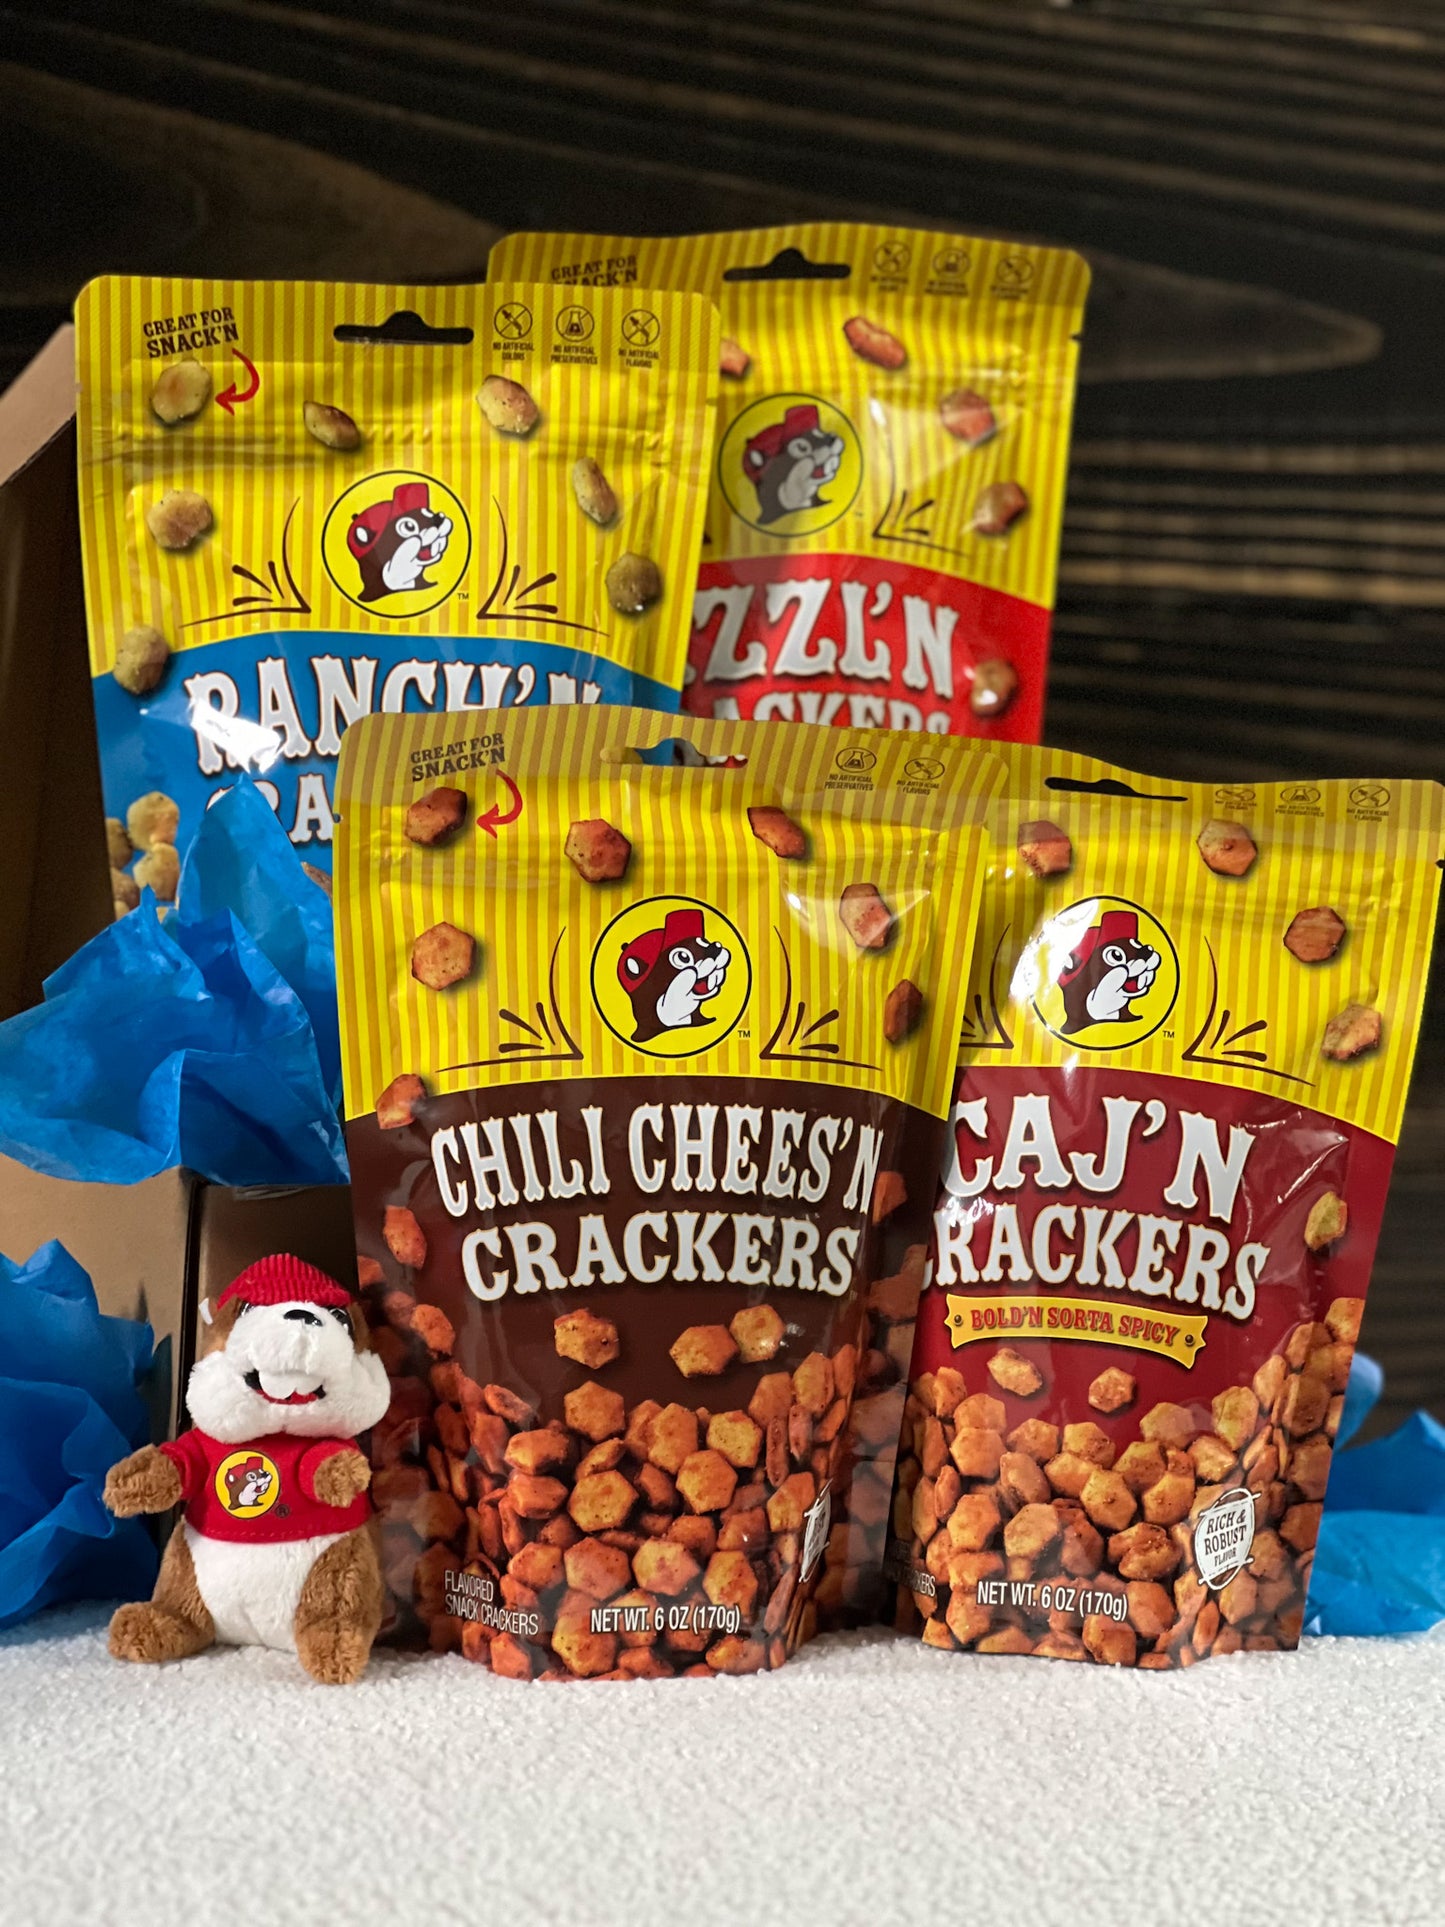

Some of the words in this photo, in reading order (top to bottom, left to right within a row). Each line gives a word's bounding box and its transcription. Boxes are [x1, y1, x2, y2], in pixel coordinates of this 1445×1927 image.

[551, 260, 602, 281] GREAT
[606, 254, 637, 271] FOR
[143, 313, 197, 338] GREAT
[200, 306, 235, 326] FOR
[146, 322, 239, 359] SNACK'N
[410, 741, 467, 764] GREAT
[470, 732, 505, 751] FOR
[411, 746, 506, 783] SNACK'N
[430, 1104, 612, 1217] CHILI
[627, 1101, 885, 1215] CHEES'N
[941, 1092, 1256, 1223] CAJ'N
[461, 1209, 861, 1302] CRACKERS
[921, 1202, 1272, 1321] RACKERS
[970, 1305, 1043, 1331] BOLD'N
[1046, 1307, 1114, 1334] SORTA
[1118, 1313, 1180, 1346] SPICY
[1203, 1524, 1247, 1556] ROBUST
[1206, 1510, 1237, 1535] RICH
[1236, 1508, 1247, 1524] &
[1214, 1547, 1237, 1567] FLAVOR
[444, 1569, 495, 1603] FLAVORED
[976, 1580, 1008, 1607] NET
[1010, 1582, 1038, 1608] WT.
[1040, 1584, 1051, 1608] 6
[1053, 1586, 1076, 1612] OZ
[1078, 1590, 1129, 1622] (170g)
[444, 1594, 480, 1622] SNACK
[480, 1603, 539, 1636] CRACKERS
[590, 1608, 621, 1633] NET
[622, 1607, 651, 1632] WT.
[653, 1607, 665, 1631] 6
[668, 1606, 691, 1631] OZ
[692, 1604, 741, 1635] (170g)
